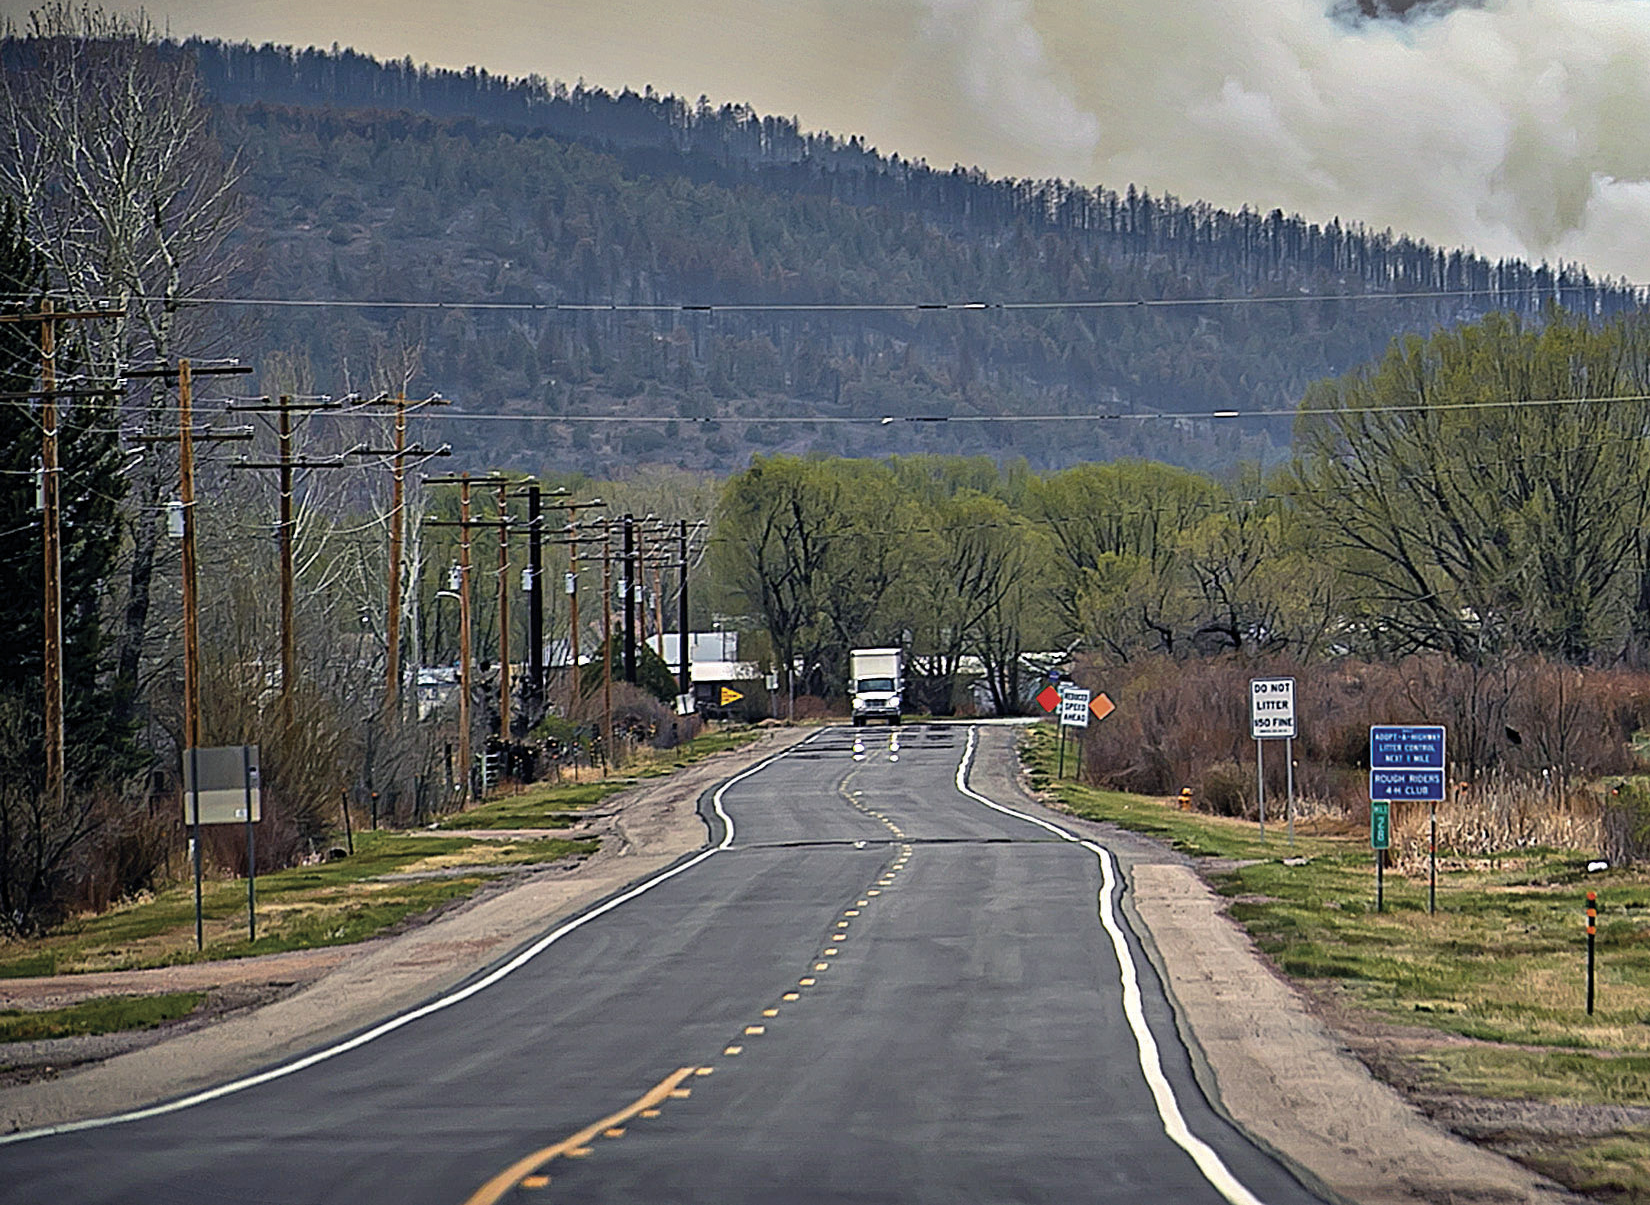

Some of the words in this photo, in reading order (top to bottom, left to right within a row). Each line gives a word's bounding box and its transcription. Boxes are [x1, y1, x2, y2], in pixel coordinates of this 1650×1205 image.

[1254, 683, 1268, 694] DO
[1270, 682, 1290, 692] NOT
[1256, 700, 1289, 710] LITTER
[1272, 717, 1293, 727] FINE
[1385, 754, 1403, 763] NEXT
[1413, 754, 1430, 763] MILE
[1375, 773, 1405, 784] ROUGH
[1409, 774, 1441, 784] RIDERS
[1404, 786, 1429, 795] CLUB
